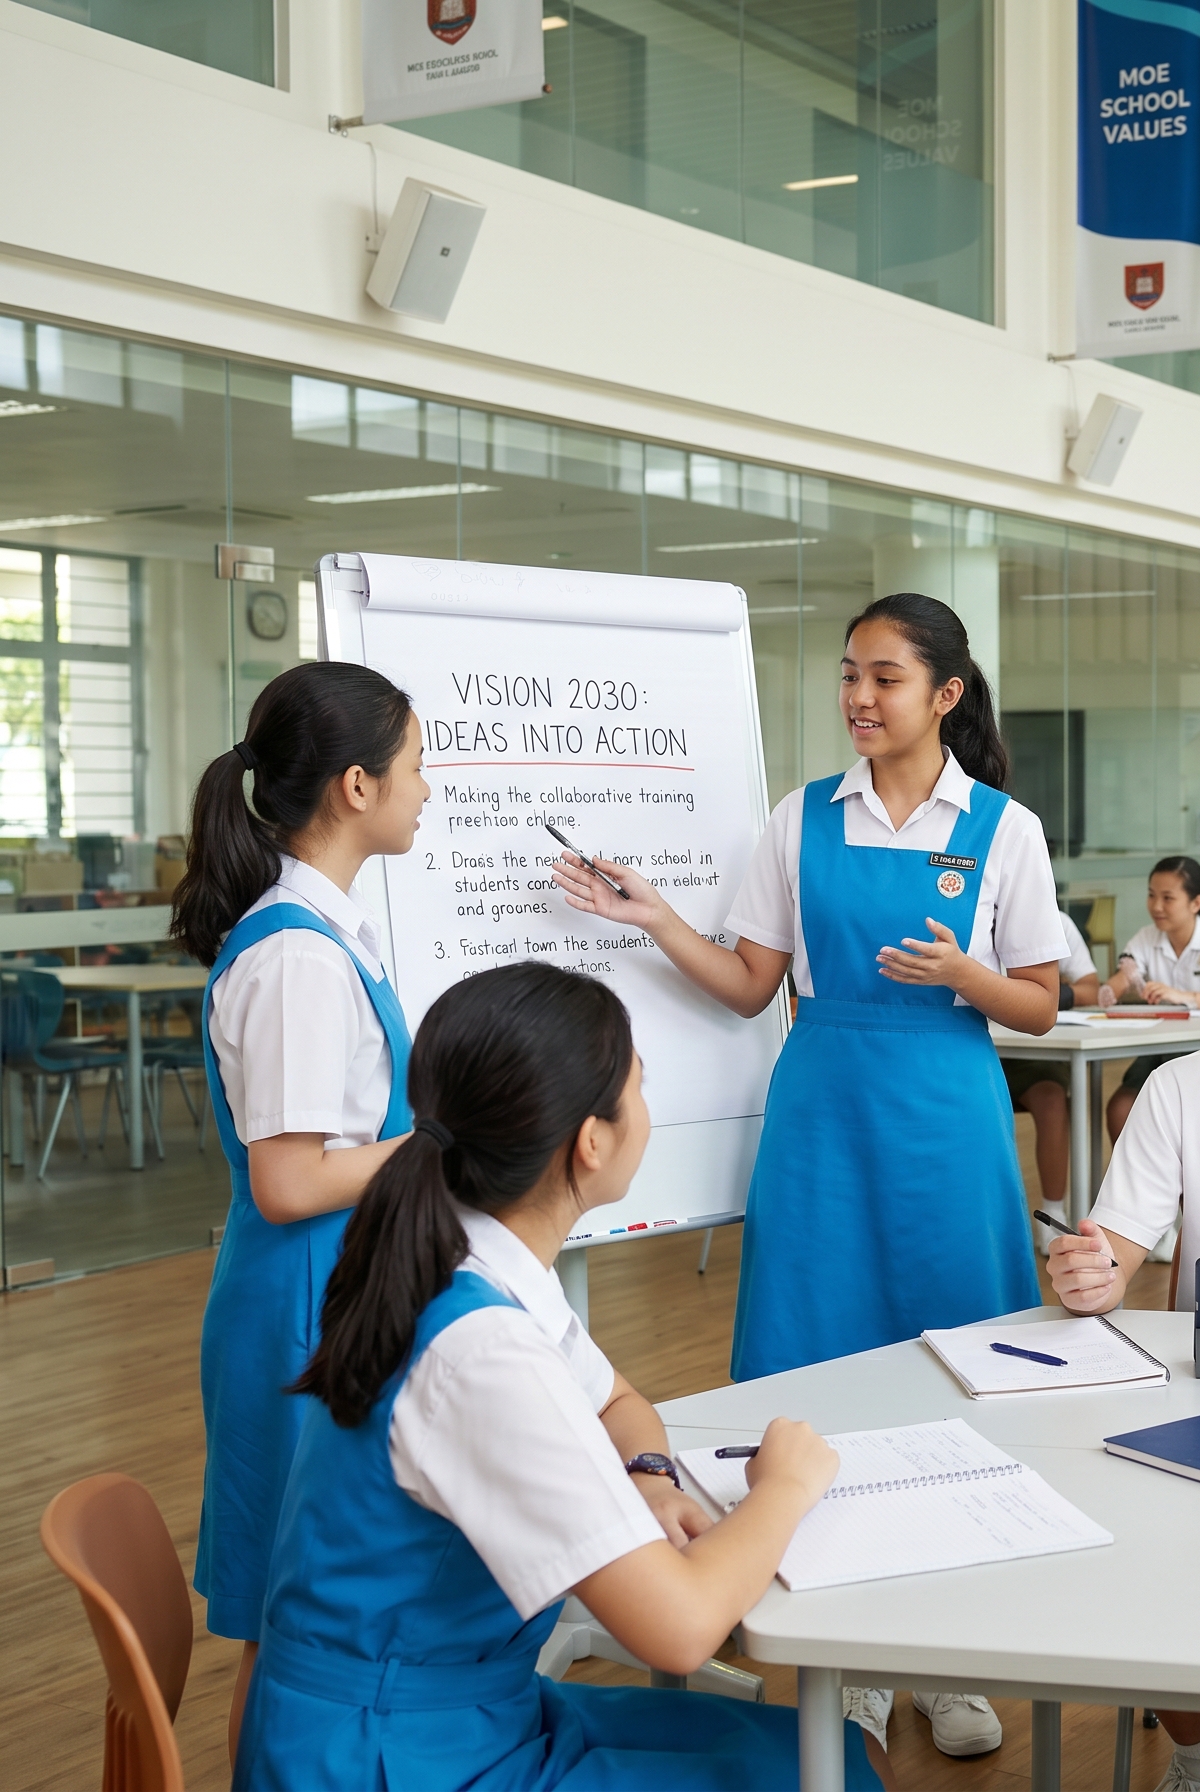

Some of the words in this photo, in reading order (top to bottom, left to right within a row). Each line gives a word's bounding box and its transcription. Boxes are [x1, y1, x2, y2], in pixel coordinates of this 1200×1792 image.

[1119, 62, 1171, 89] MOE
[1100, 88, 1191, 118] SCHOOL
[1103, 115, 1188, 145] VALUES
[451, 672, 552, 708] VISION
[567, 678, 648, 711] 2030:
[425, 720, 508, 753] IDEAS
[522, 723, 583, 754] INTO
[595, 726, 688, 756] ACTION
[444, 785, 500, 811] Making
[507, 785, 532, 803] the
[539, 786, 632, 803] collaborative
[639, 787, 695, 812] training
[425, 852, 441, 870] 2.
[502, 850, 528, 868] the
[650, 849, 692, 865] school
[699, 851, 713, 865] in
[455, 874, 520, 893] students
[457, 899, 485, 916] and
[434, 941, 451, 959] 3.
[524, 936, 557, 953] town
[564, 935, 589, 951] the
